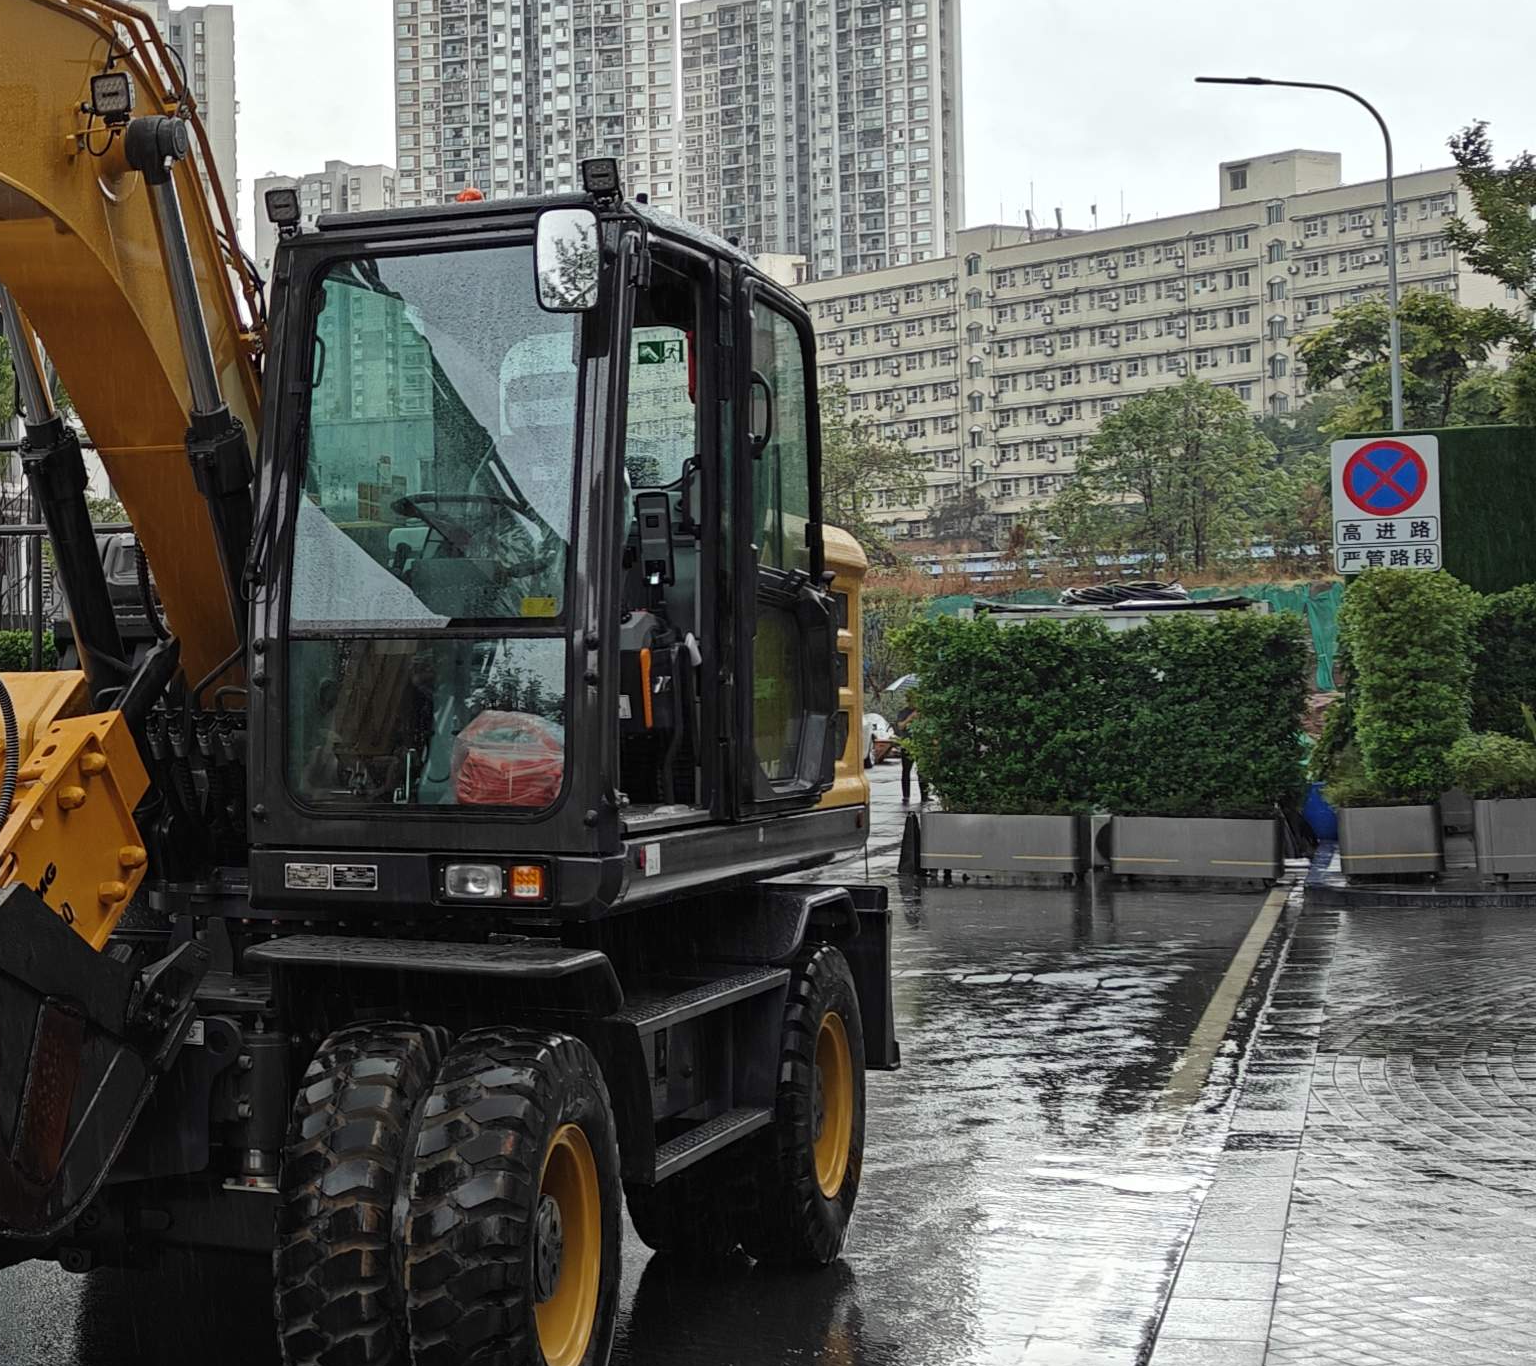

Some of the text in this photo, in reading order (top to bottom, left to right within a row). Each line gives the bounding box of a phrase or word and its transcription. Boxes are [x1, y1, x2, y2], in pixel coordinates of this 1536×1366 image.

[1341, 520, 1432, 542] 高进路
[1340, 547, 1435, 570] 严管路段
